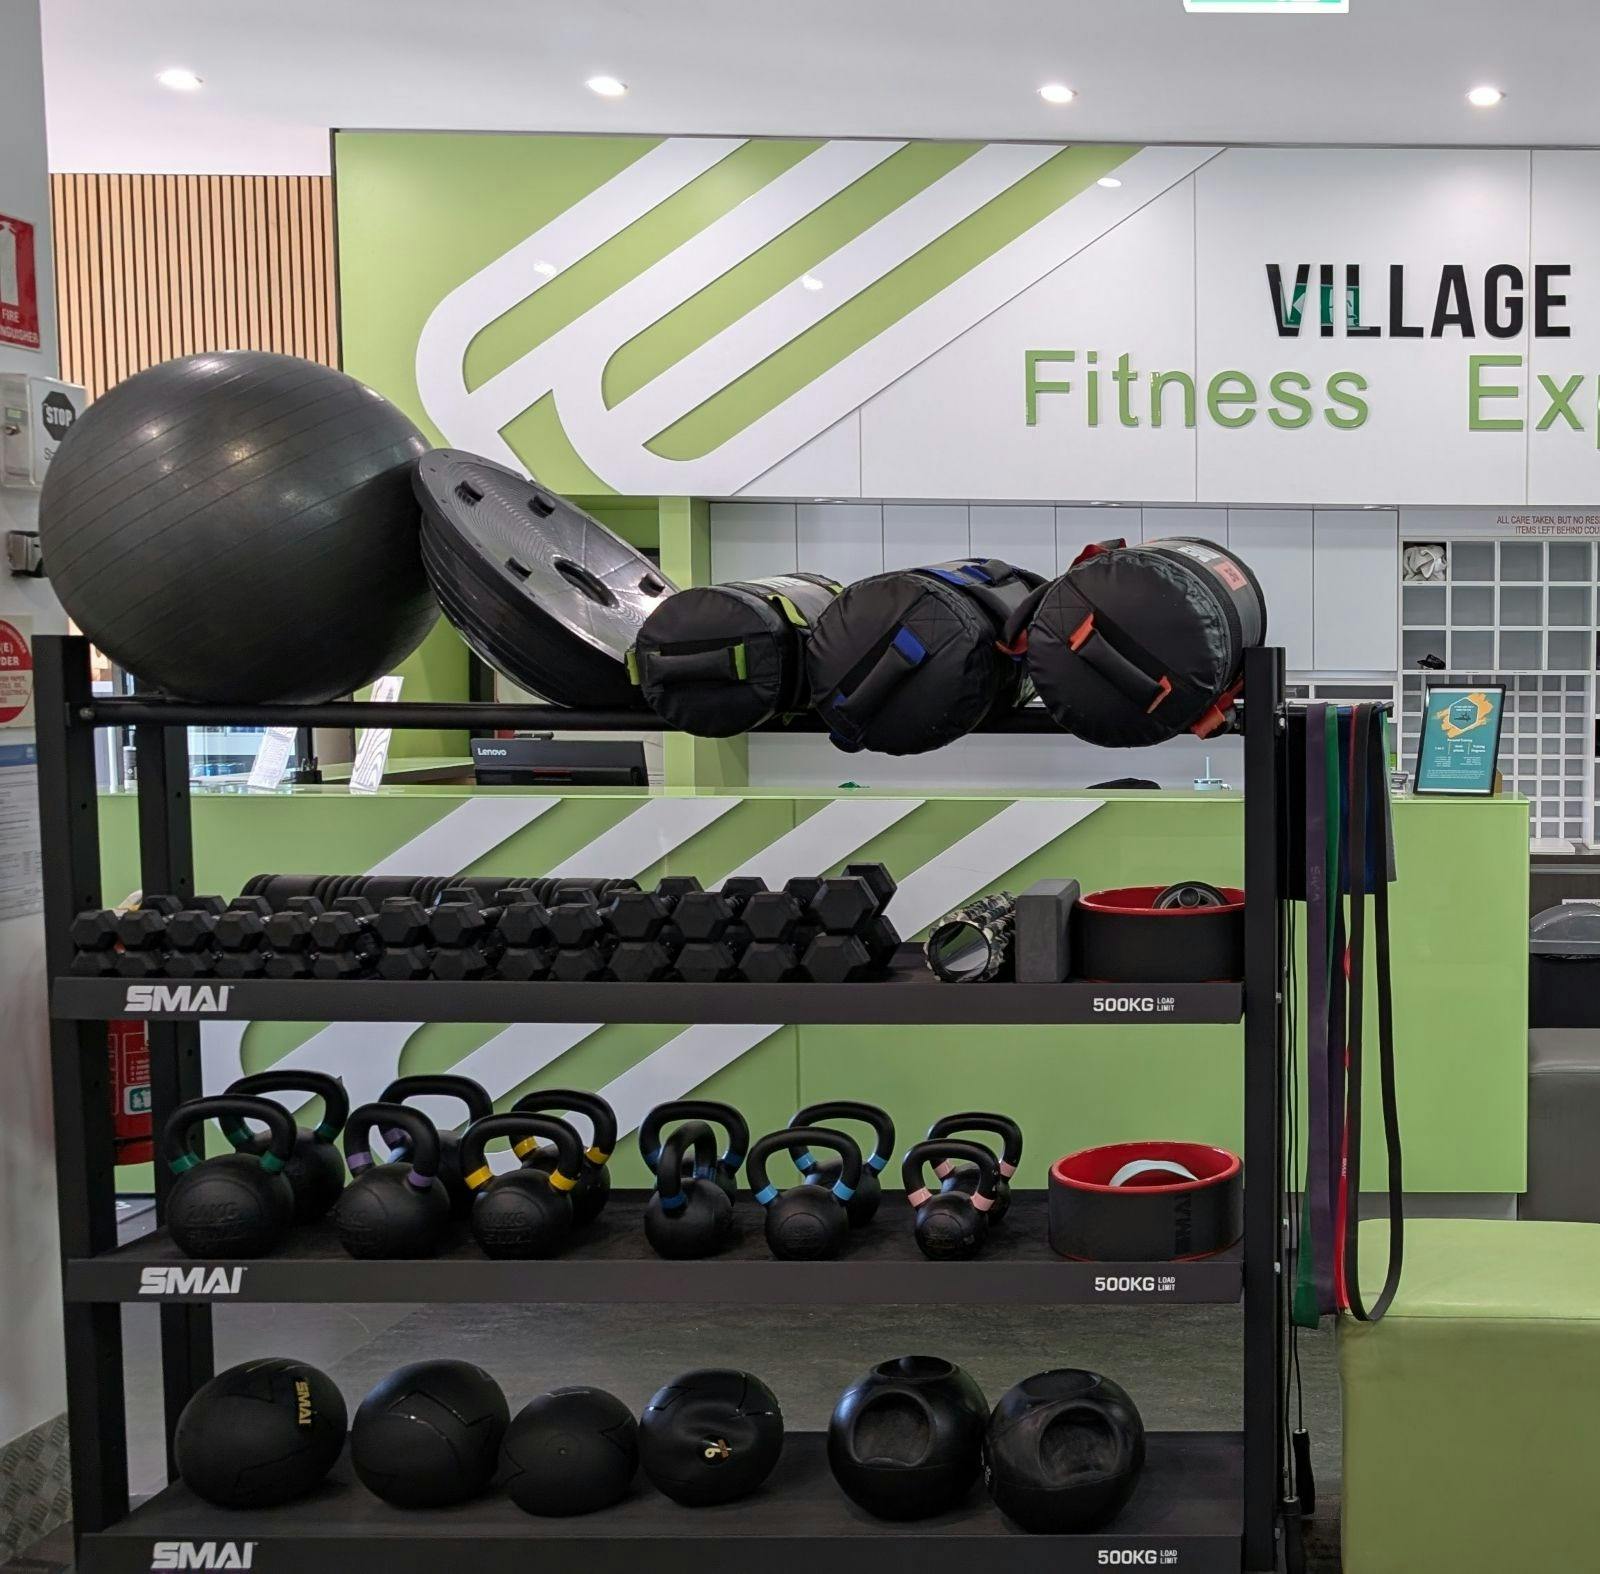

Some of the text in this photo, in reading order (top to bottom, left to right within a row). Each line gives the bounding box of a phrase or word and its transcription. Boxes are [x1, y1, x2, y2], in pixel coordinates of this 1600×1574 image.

[1266, 264, 1571, 337] VILLAGE
[2, 308, 20, 323] FIRE
[1025, 350, 1600, 450] Fitness Ex
[45, 406, 73, 427] STOP
[1497, 516, 1510, 524] ALL
[1511, 516, 1531, 524] CARE
[1557, 516, 1572, 524] BUT
[1573, 516, 1584, 524] NO
[1515, 526, 1537, 534] ITEMS
[1538, 526, 1555, 534] LEFT
[1556, 526, 1583, 534] BEHIND
[477, 747, 507, 756] Lenovo
[124, 985, 229, 1012] SMAI
[1093, 998, 1154, 1012] 500KG
[138, 1267, 243, 1294] SMAI
[1094, 1277, 1155, 1292] 500KG
[295, 1380, 312, 1424] SMAI
[150, 1541, 253, 1569] SMAI
[1098, 1549, 1157, 1564] 500KG
